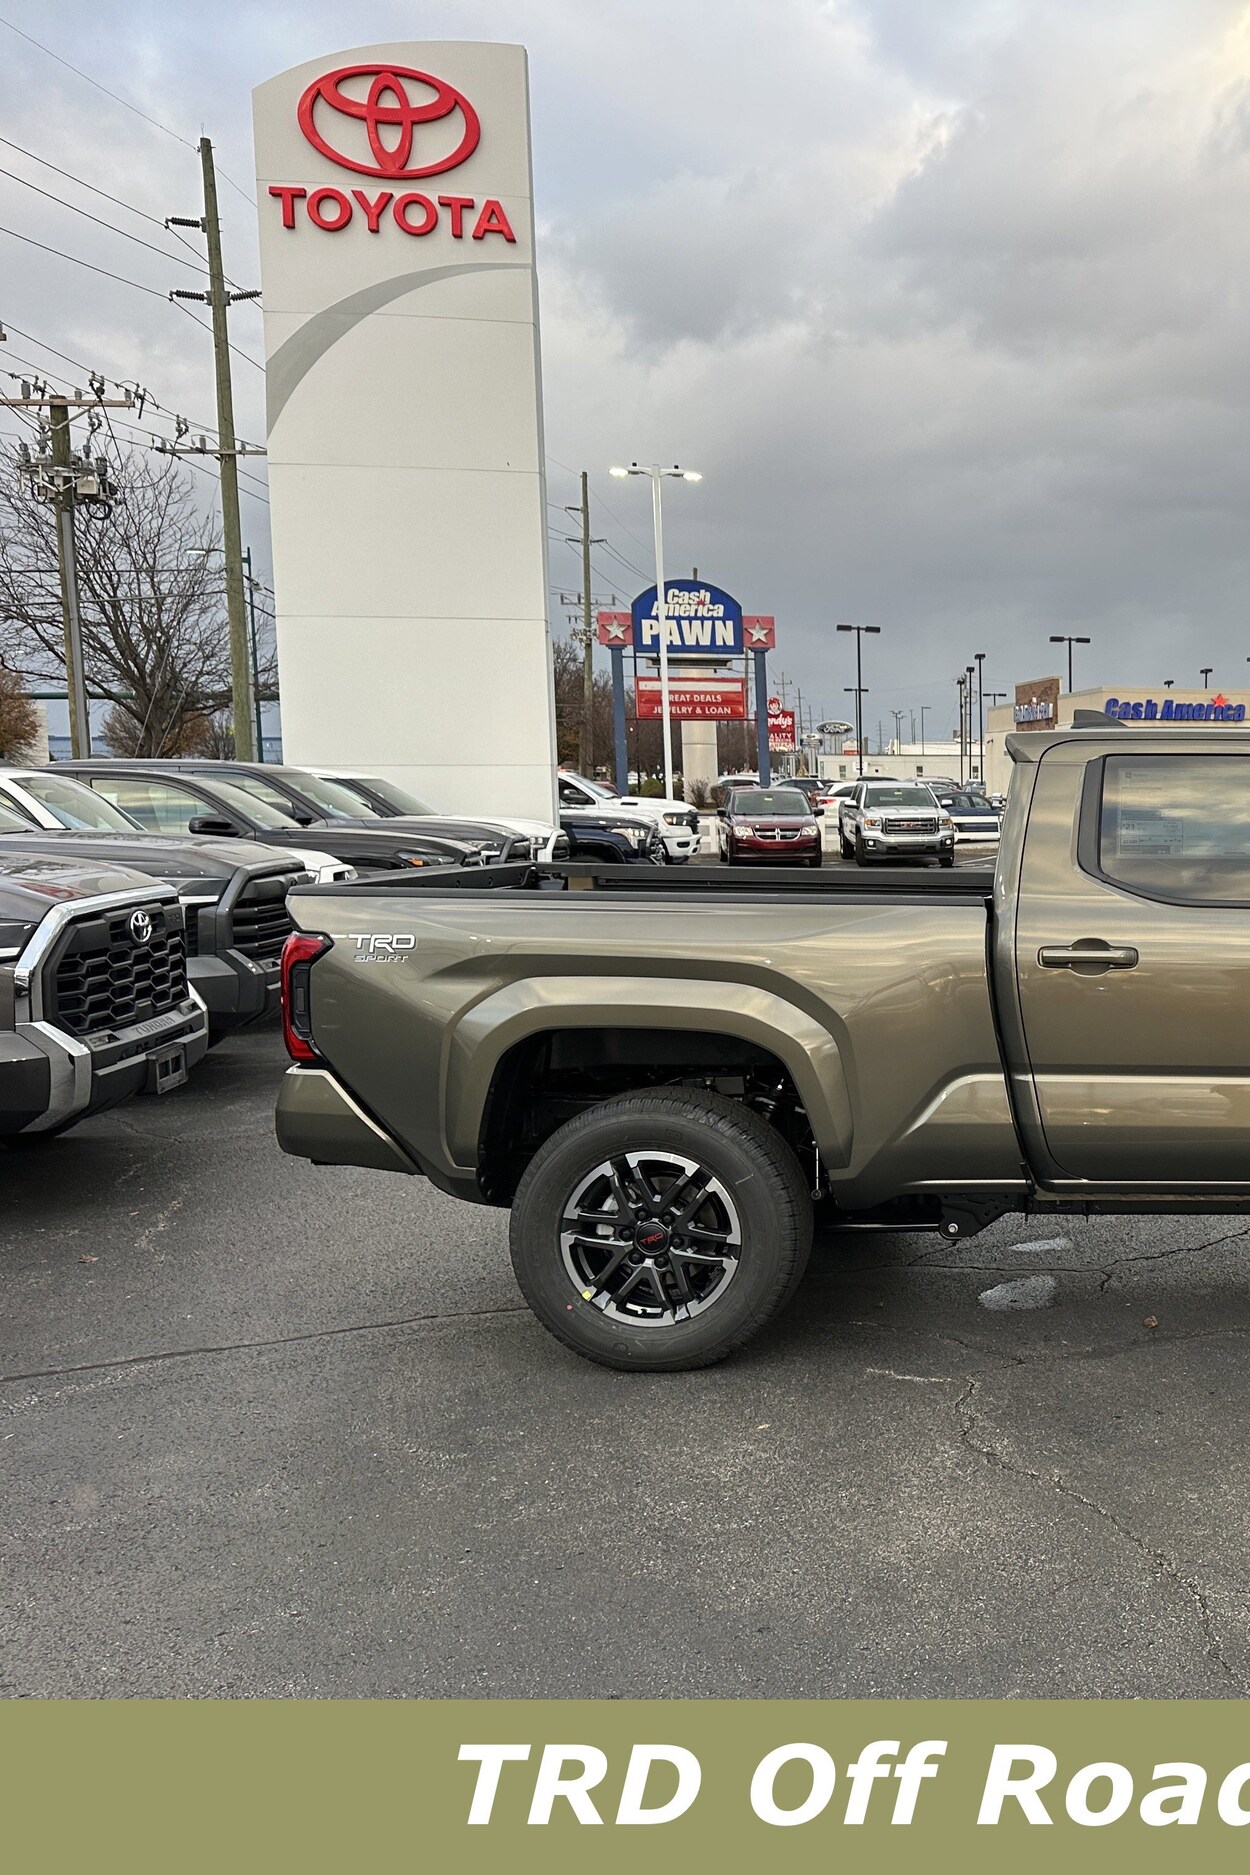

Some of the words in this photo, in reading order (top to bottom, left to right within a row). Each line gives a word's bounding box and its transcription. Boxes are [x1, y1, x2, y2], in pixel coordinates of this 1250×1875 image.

[268, 186, 517, 243] TOYOTA
[667, 588, 711, 604] Cash
[651, 601, 724, 617] America
[641, 619, 735, 646] PAWN
[661, 694, 691, 702] REAT
[693, 694, 722, 702] DEALS
[653, 706, 692, 714] JEELRY
[1105, 698, 1158, 719] Cash
[1161, 699, 1246, 722] America
[767, 713, 793, 729] ndy's
[348, 933, 416, 954] TRD
[354, 955, 409, 963] SPORT
[131, 1015, 176, 1036] TUNDRA
[639, 1232, 664, 1245] TRD
